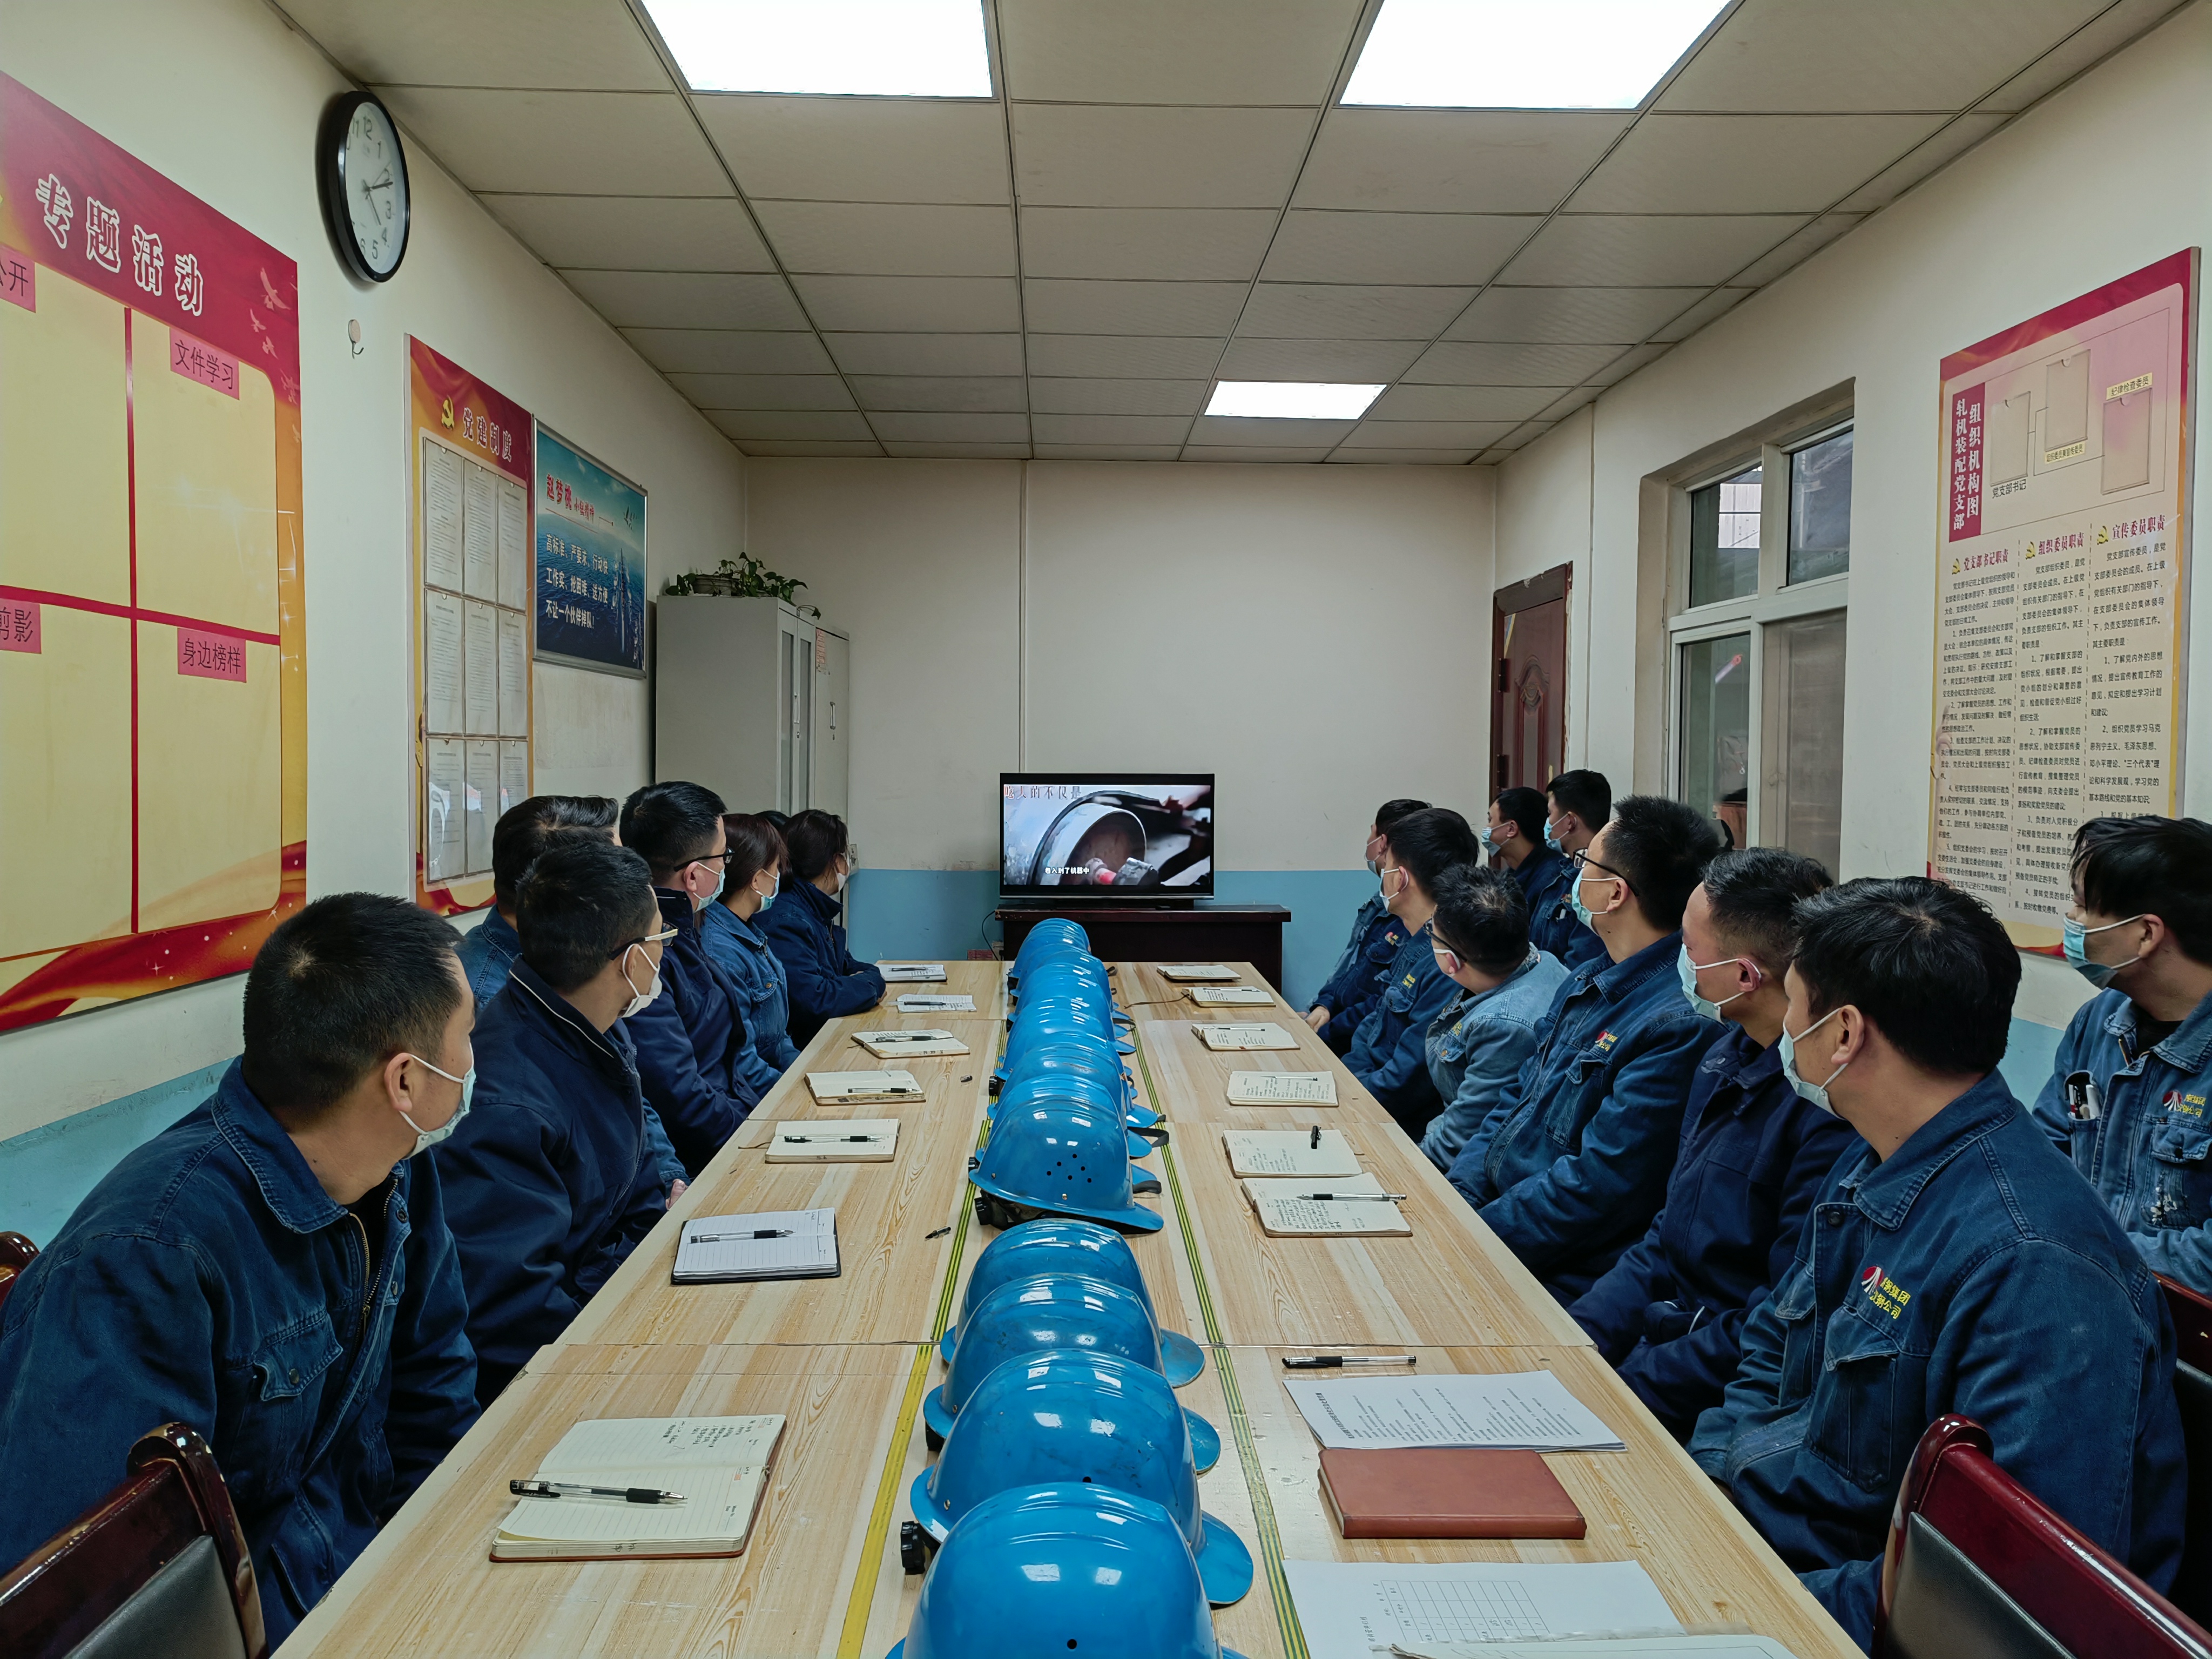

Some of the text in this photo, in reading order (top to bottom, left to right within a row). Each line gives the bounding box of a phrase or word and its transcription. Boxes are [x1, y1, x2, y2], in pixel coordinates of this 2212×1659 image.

[363, 116, 372, 140] 12
[377, 141, 381, 159] 1
[385, 200, 392, 219] 3
[36, 173, 204, 316] 专题活动
[372, 240, 379, 259] 5
[175, 340, 233, 389] 文件学习
[2111, 376, 2149, 396] 纪律检查委员
[463, 407, 512, 463] 党建制度
[1953, 399, 1967, 530] 轧机装配党支部
[1966, 403, 1981, 517] 组织机构图
[547, 473, 572, 510] 赵梦桃
[1992, 479, 2026, 499] 党支部书记
[2112, 514, 2165, 540] 宣传委员职责
[546, 534, 609, 575] 高标准、严要求、行动快
[2038, 532, 2084, 555] 组织委员职责
[1964, 549, 2008, 571] 党支部书记职责
[2093, 597, 2164, 615] 在支部委员会的集体领导
[0, 607, 33, 642] 剪影
[182, 638, 241, 675] 身边榜样
[2105, 651, 2163, 665] 1、了解党内外的思想
[2102, 724, 2161, 733] 2、组织党员学习马克
